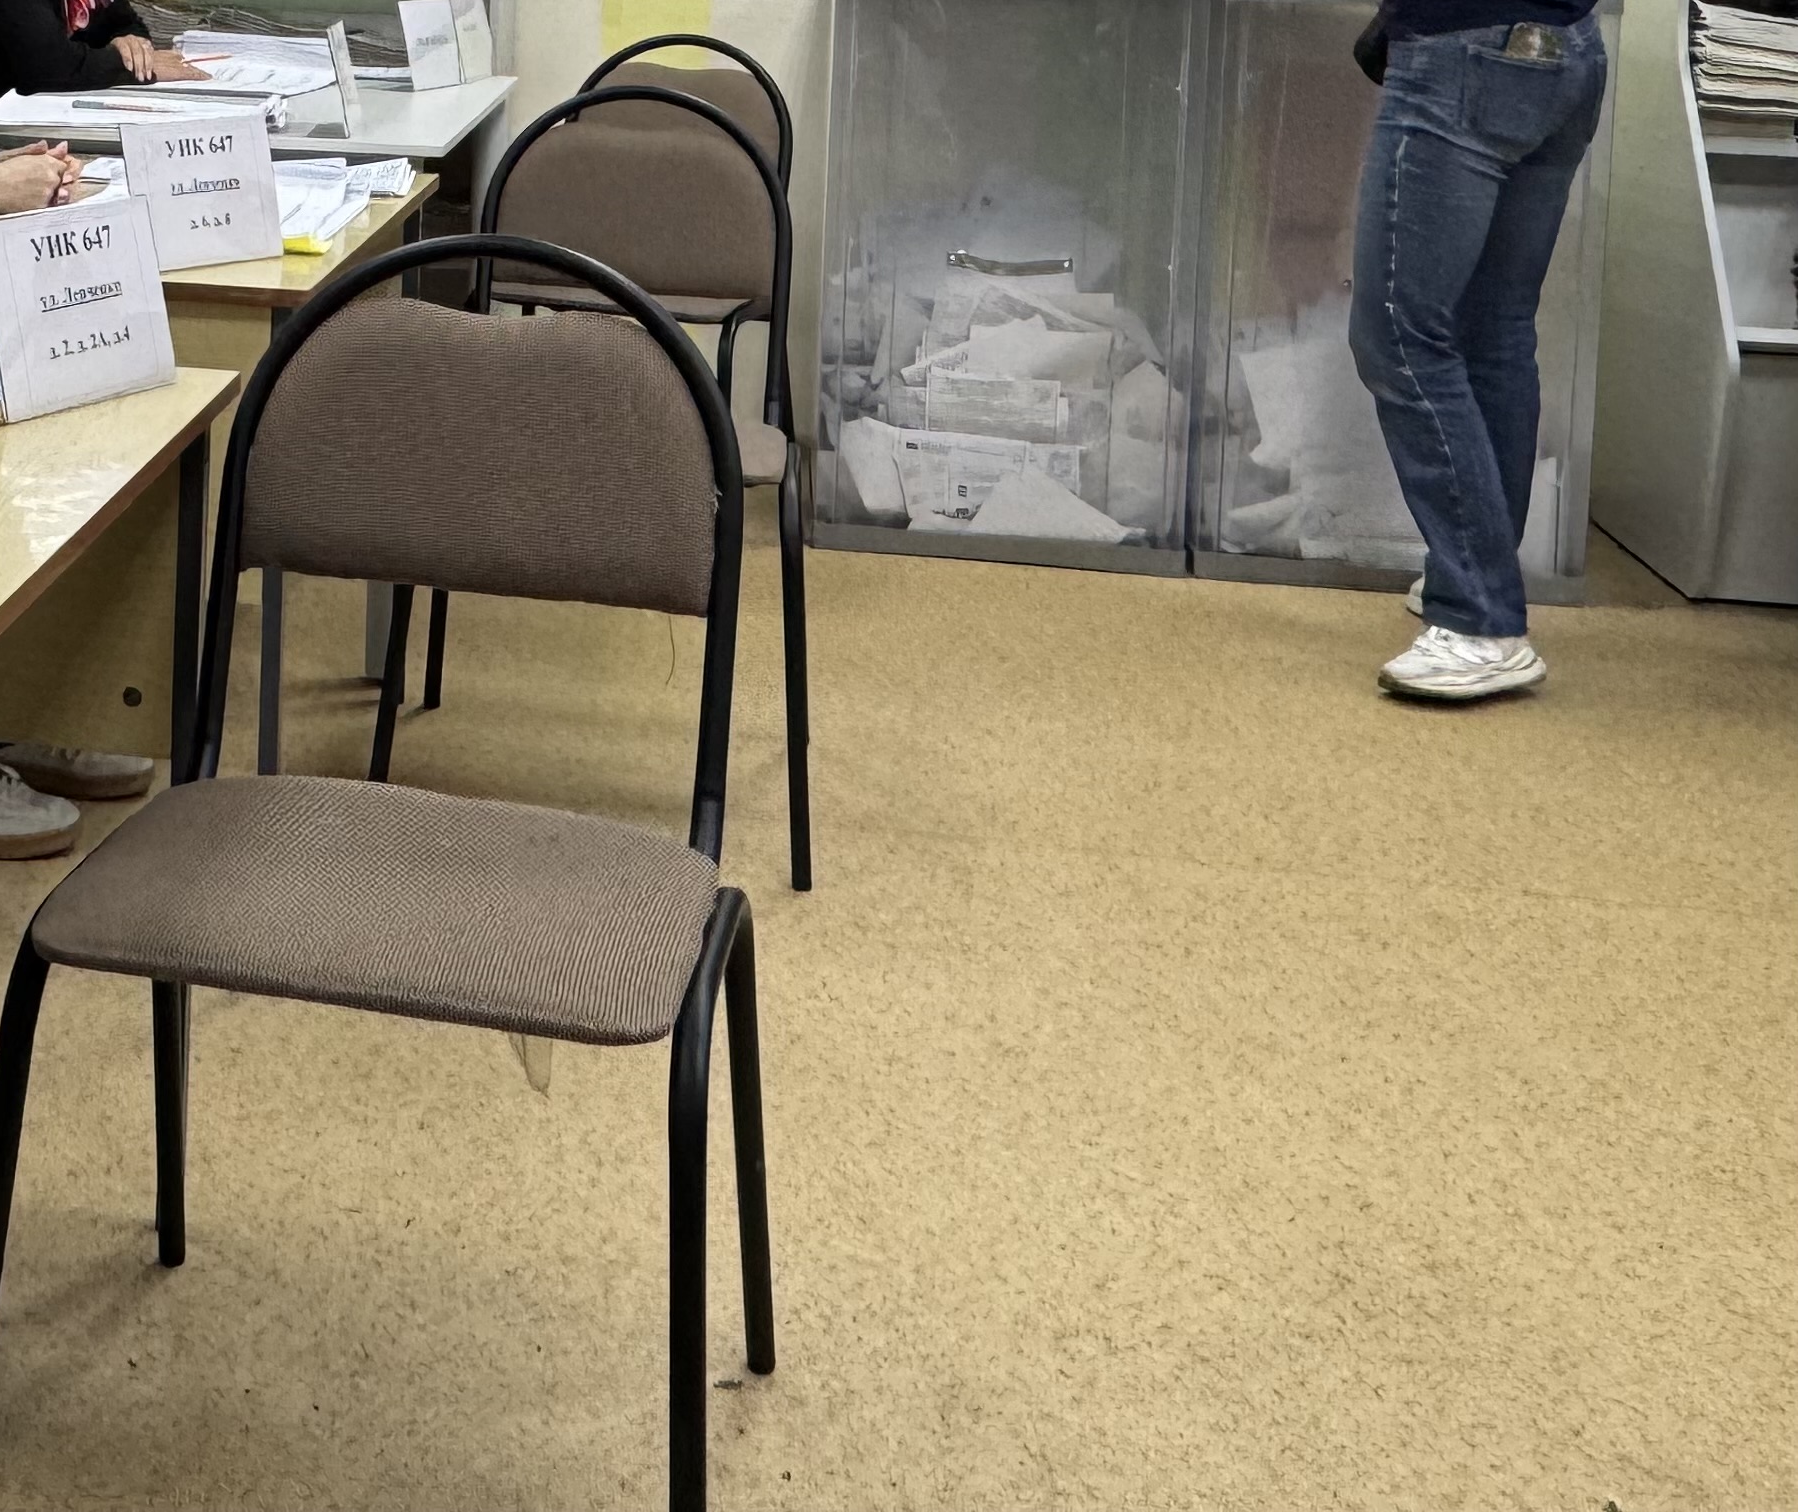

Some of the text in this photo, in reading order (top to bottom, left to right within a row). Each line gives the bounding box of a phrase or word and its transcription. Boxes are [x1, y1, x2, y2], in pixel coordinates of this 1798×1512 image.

[165, 135, 233, 159] УИК 647
[30, 225, 110, 262] УИК 647
